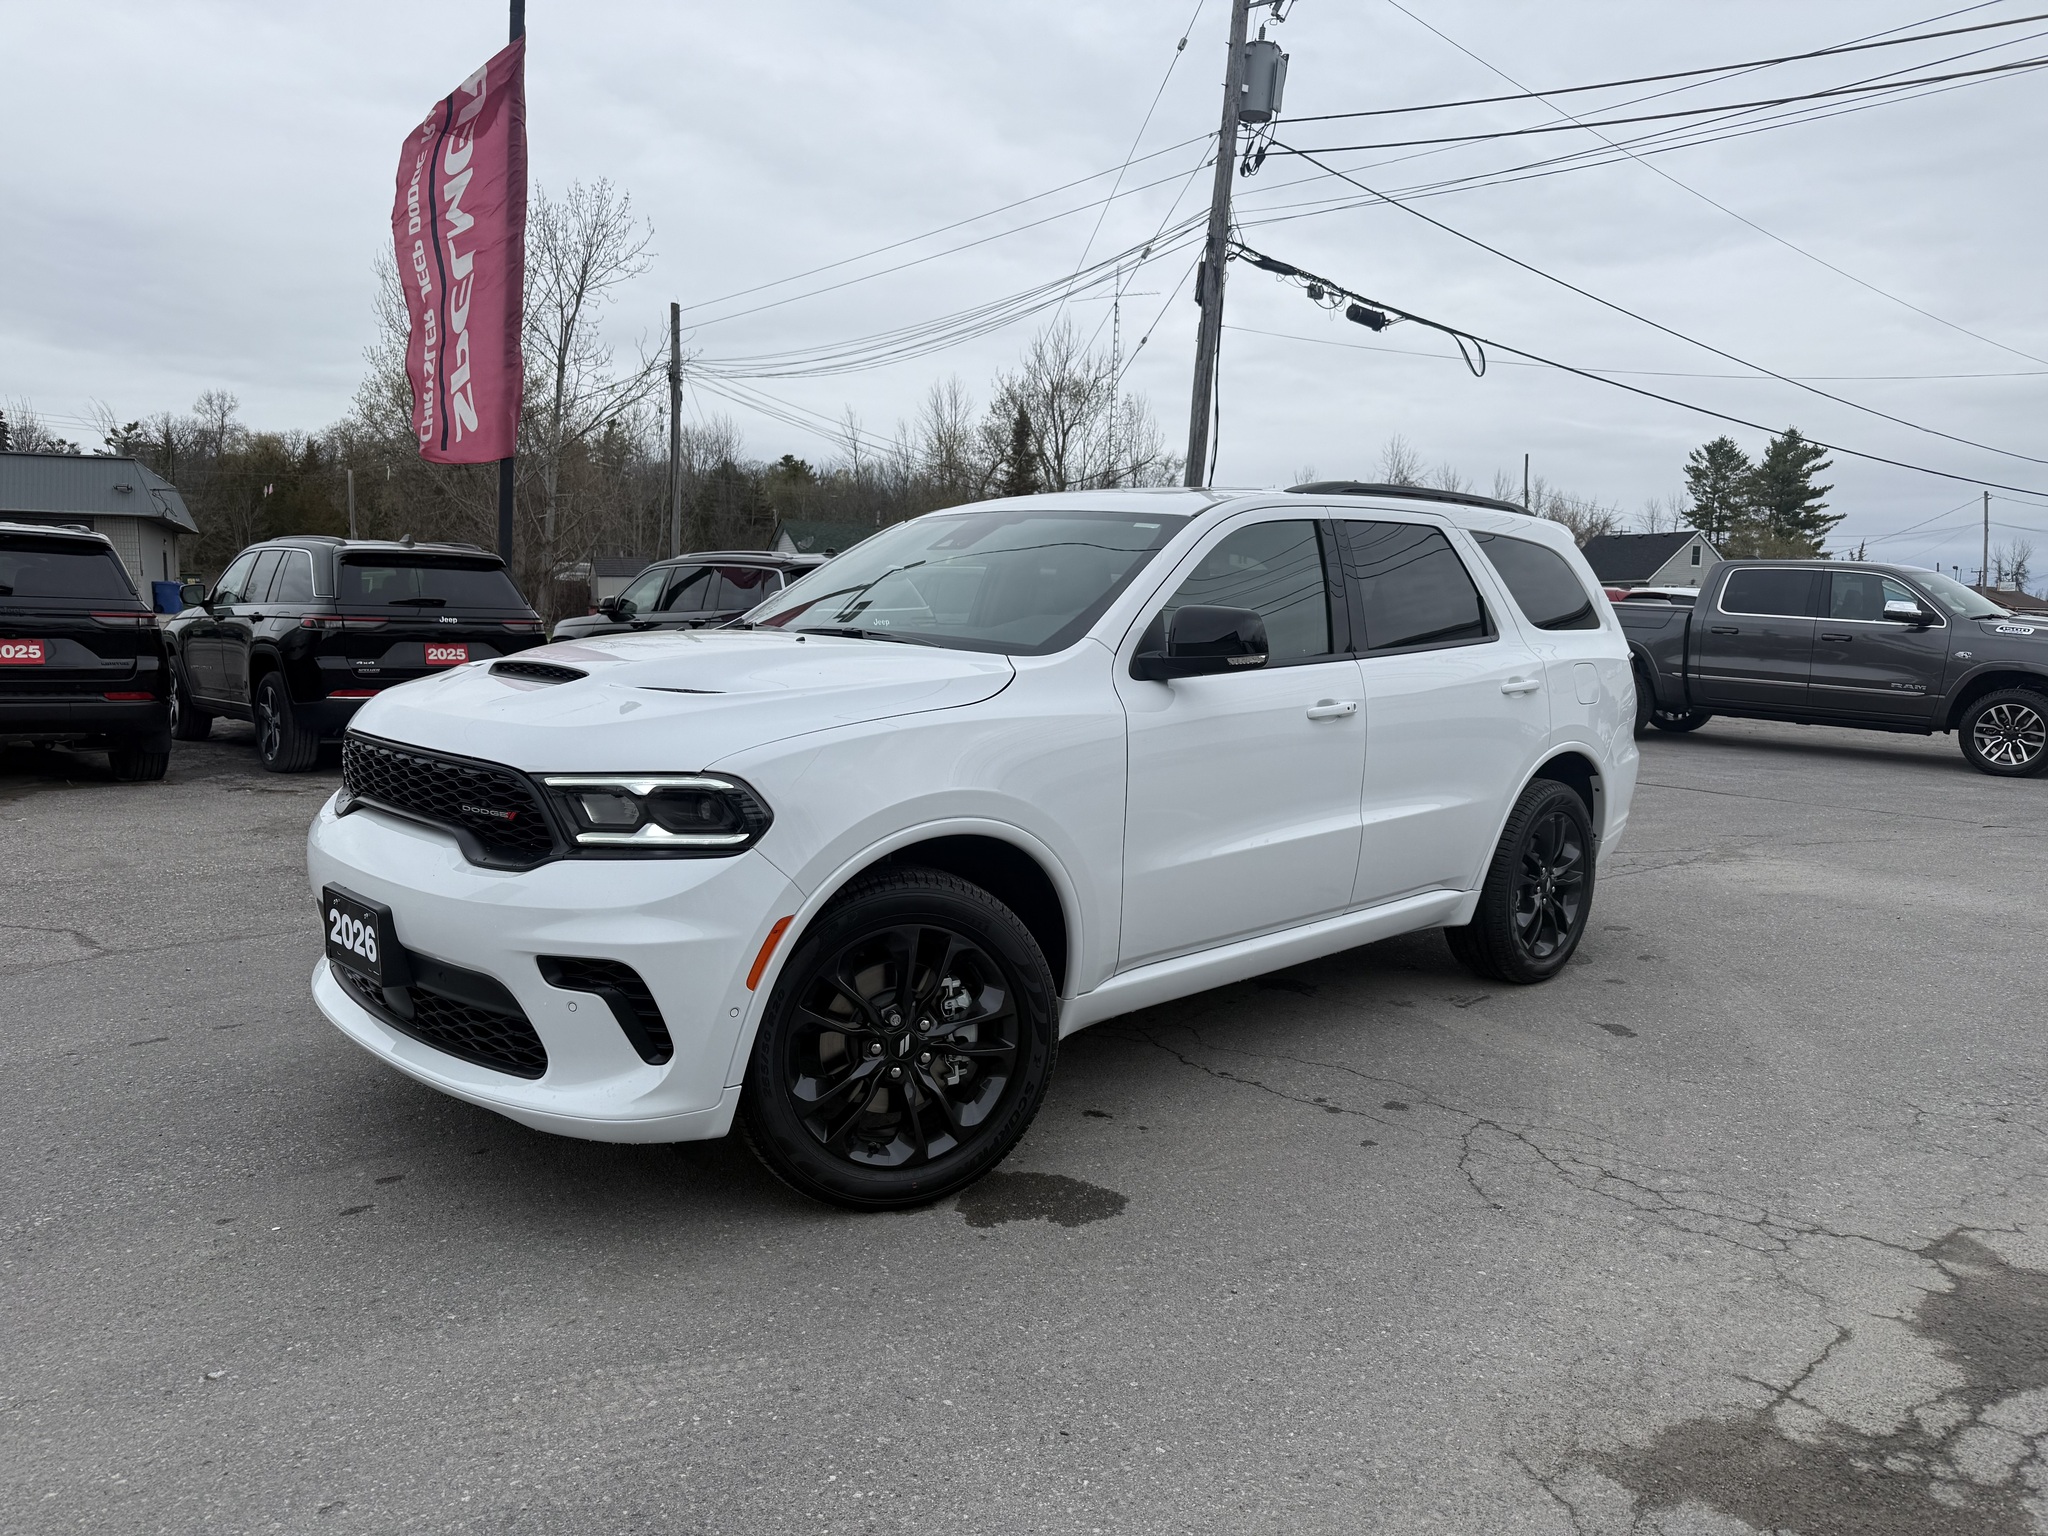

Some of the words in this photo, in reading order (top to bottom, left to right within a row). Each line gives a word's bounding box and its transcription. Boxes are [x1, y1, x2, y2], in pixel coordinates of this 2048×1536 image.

[439, 615, 458, 625] Jeep
[873, 618, 890, 626] Jeep
[0, 644, 42, 659] 025
[427, 647, 466, 661] 2025
[1890, 682, 1927, 691] RAM
[461, 804, 508, 818] DODGE
[329, 908, 377, 963] 2026
